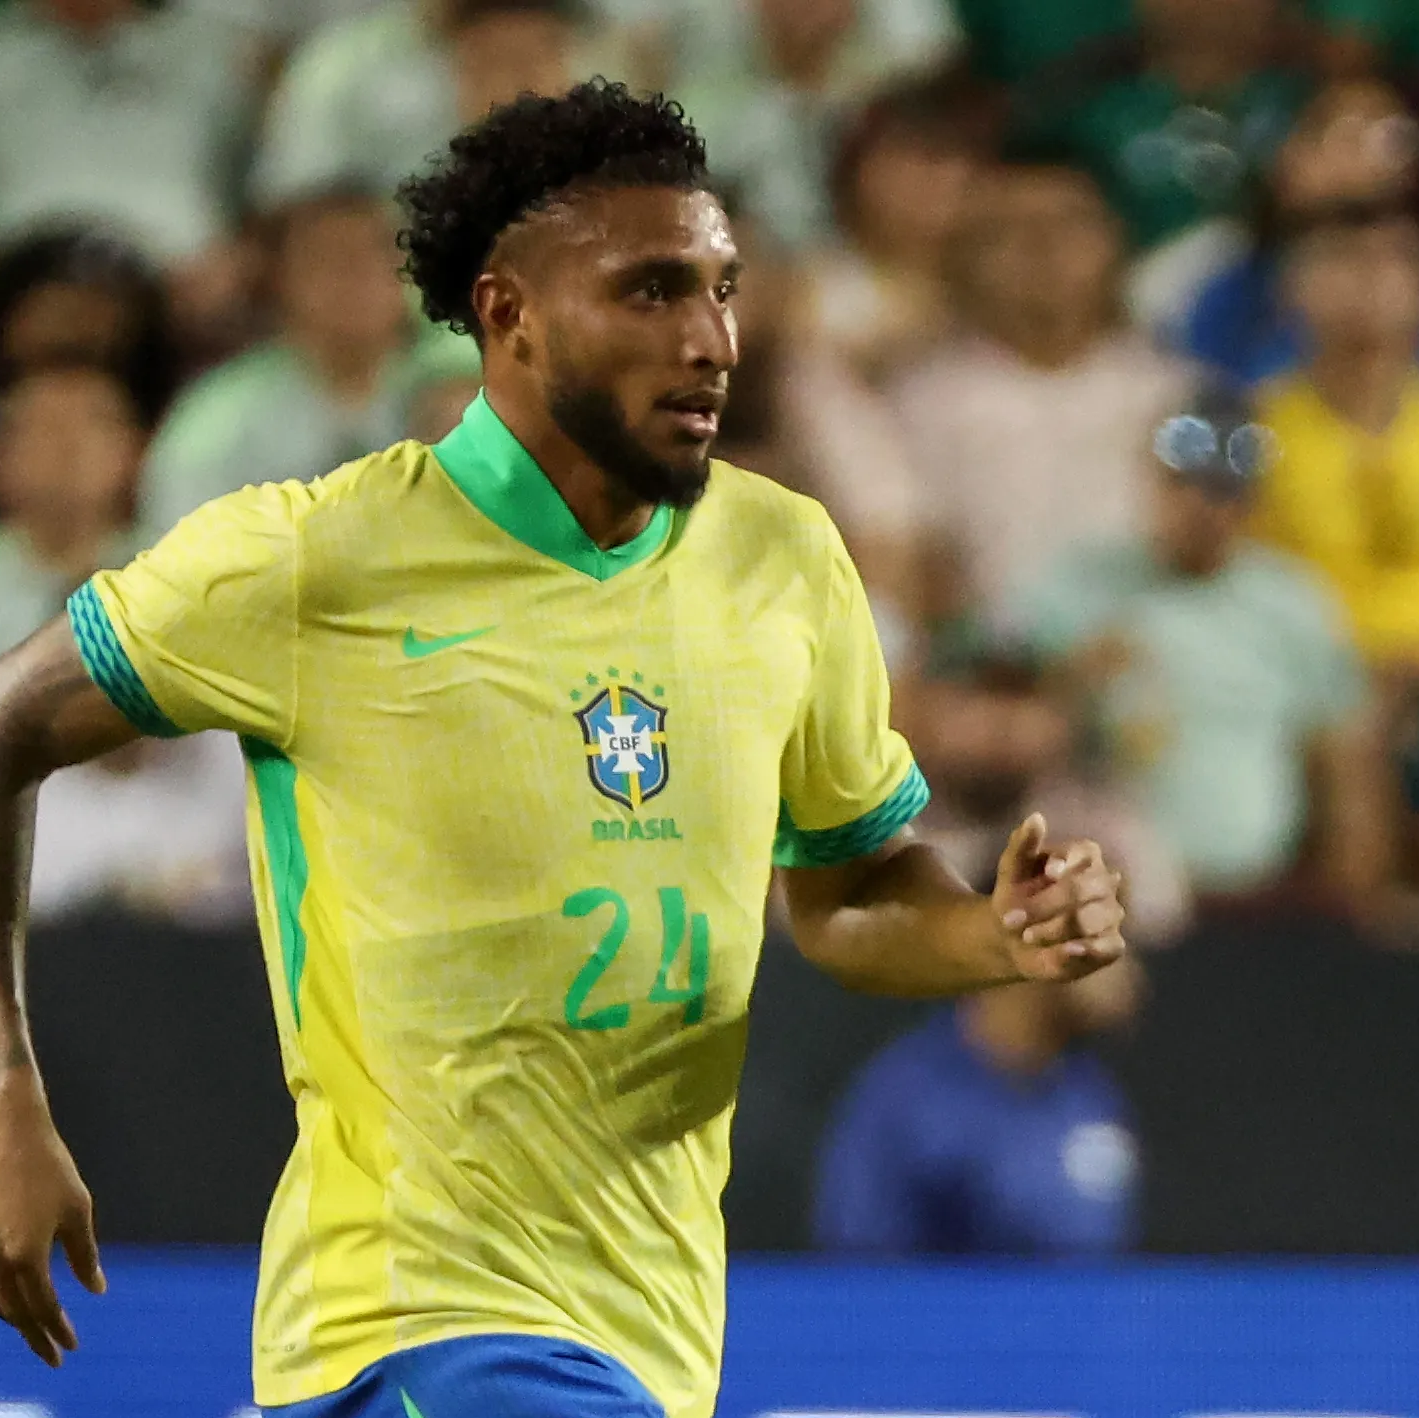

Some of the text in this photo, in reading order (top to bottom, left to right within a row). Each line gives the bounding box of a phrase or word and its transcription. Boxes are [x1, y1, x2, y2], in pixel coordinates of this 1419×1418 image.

[609, 736, 641, 751] CBF
[592, 818, 683, 840] BRASIL
[562, 887, 710, 1029] 24
